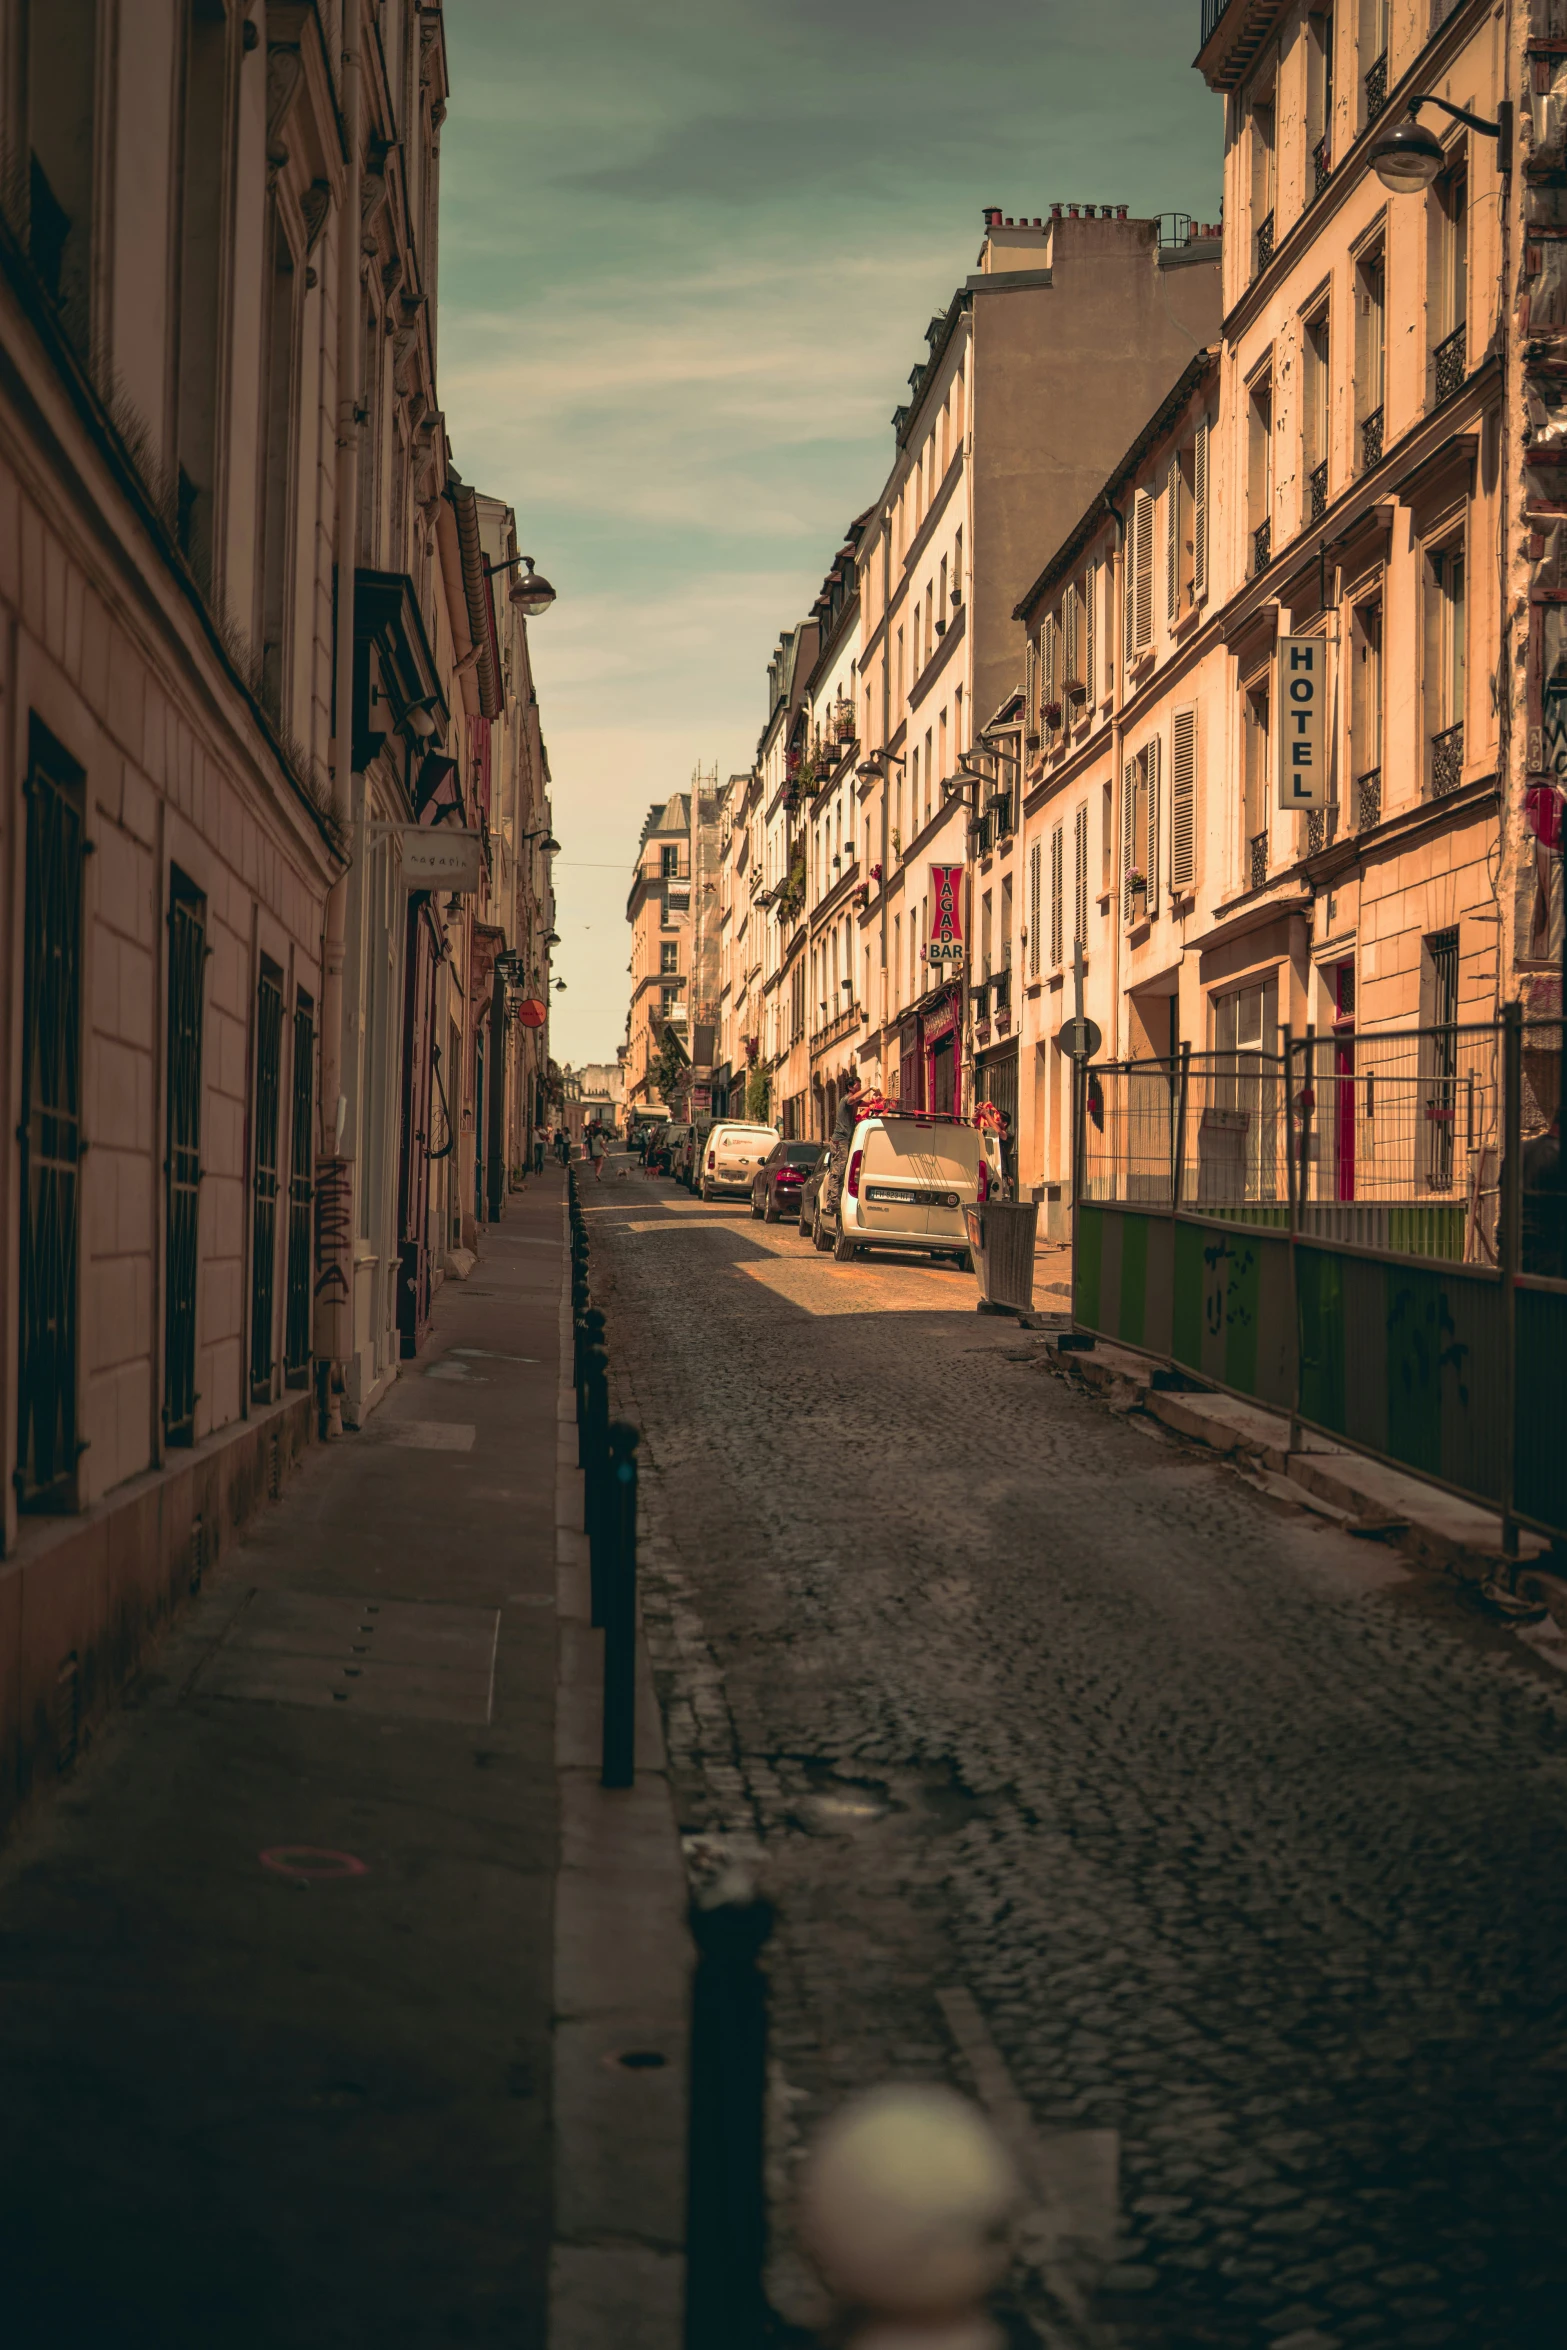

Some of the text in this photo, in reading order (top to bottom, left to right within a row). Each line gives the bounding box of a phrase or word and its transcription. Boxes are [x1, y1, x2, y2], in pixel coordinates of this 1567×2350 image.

[1289, 646, 1314, 798] HOTEL
[941, 867, 953, 943] TAGAD
[930, 944, 963, 958] BAR
